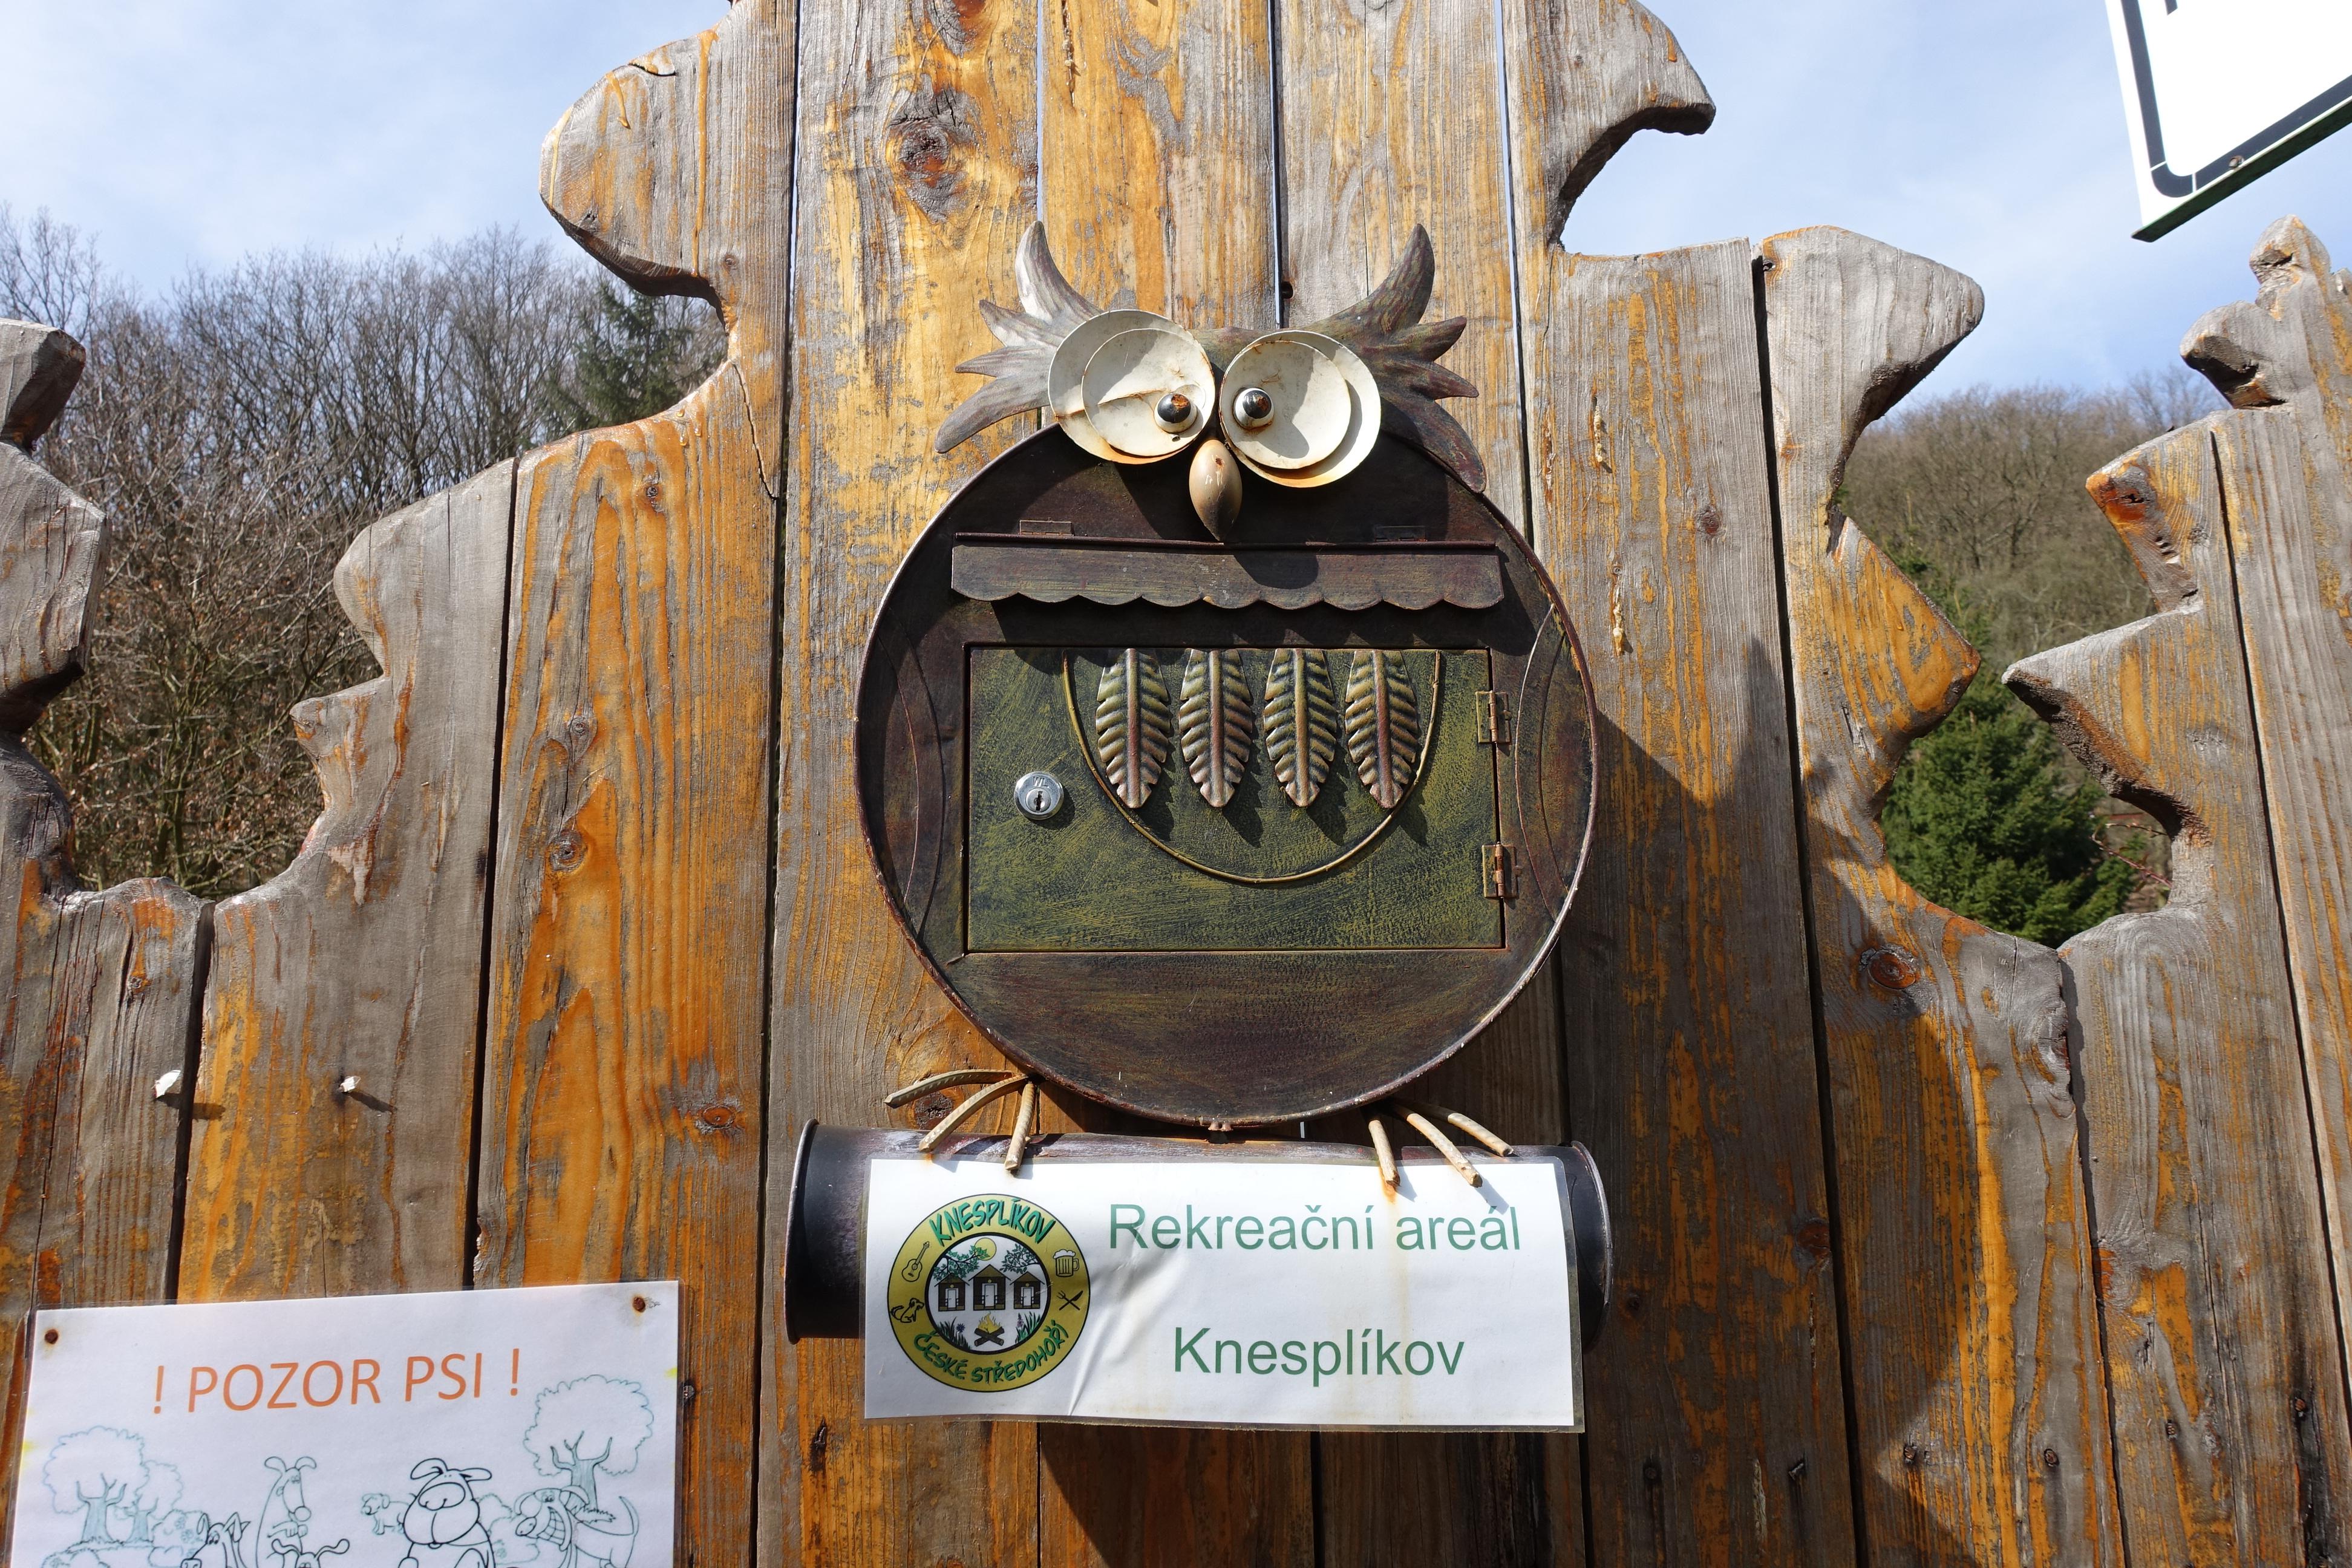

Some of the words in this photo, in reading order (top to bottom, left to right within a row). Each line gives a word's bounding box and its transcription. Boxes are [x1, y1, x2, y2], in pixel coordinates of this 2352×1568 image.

[929, 1197, 1056, 1247] KNESPLÍKOV
[1109, 1203, 1373, 1250] Rekreační
[1396, 1205, 1520, 1250] areál
[153, 1365, 165, 1414] !
[188, 1359, 381, 1413] POZOR
[403, 1353, 484, 1402] PSI
[509, 1348, 520, 1396] !
[914, 1330, 969, 1380] ČESKÉ
[971, 1319, 1069, 1385] STŘEDOHOŘÍ
[1175, 1327, 1465, 1387] Knesplíkov
